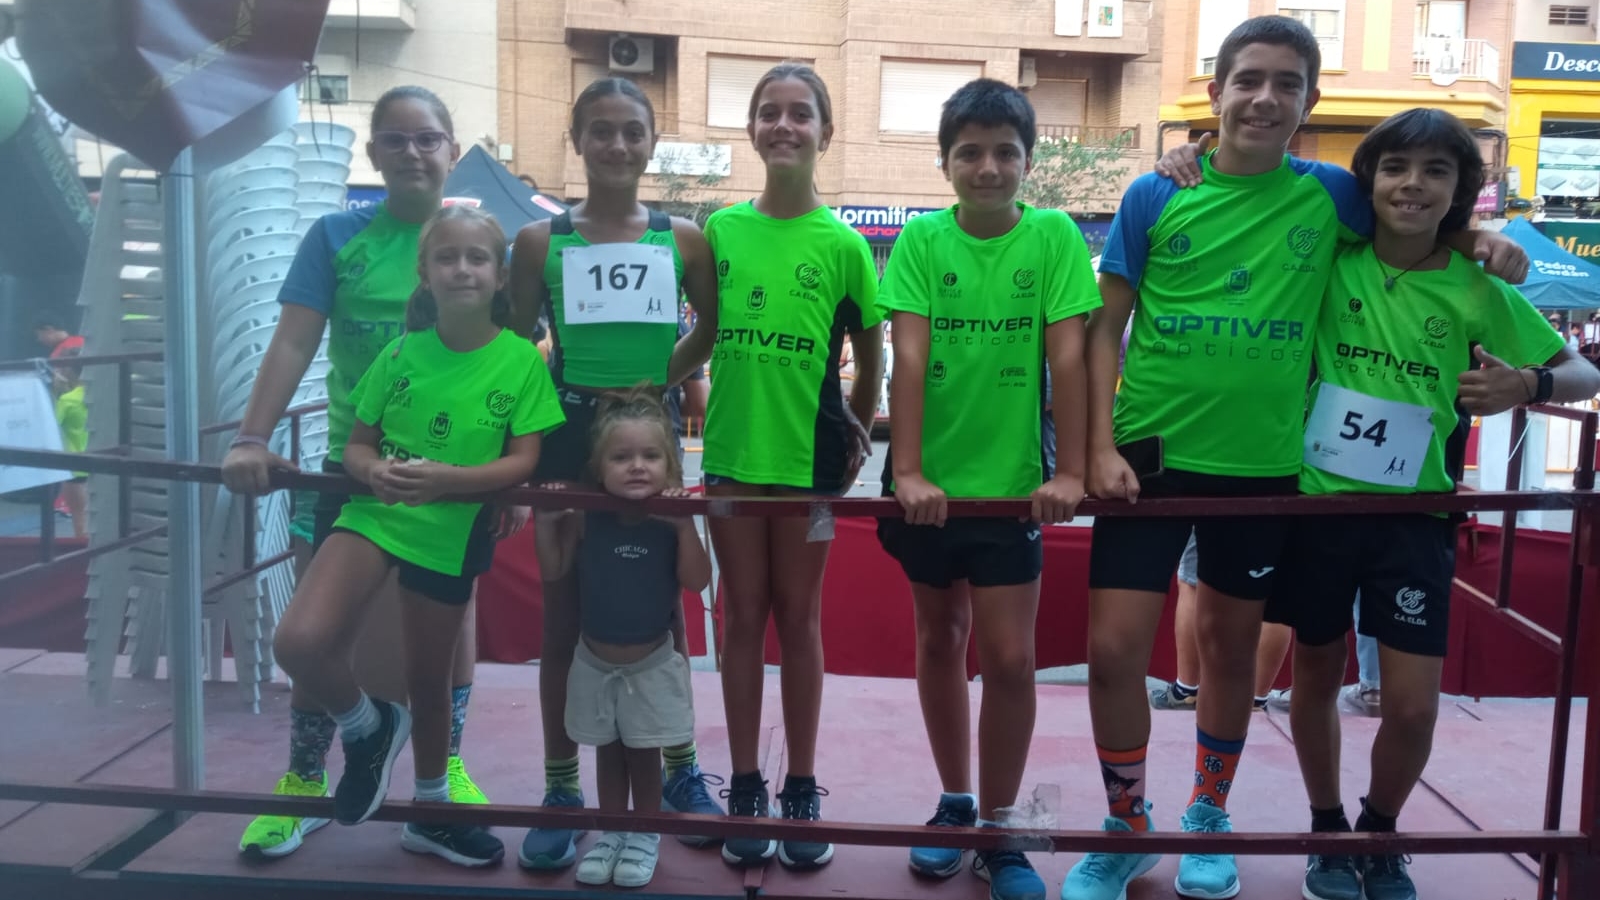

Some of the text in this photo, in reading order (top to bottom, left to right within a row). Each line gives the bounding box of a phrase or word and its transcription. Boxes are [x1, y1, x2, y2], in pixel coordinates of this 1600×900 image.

[1544, 51, 1600, 72] Desc
[587, 263, 649, 292] 167
[934, 316, 1034, 333] OPTIVER
[1154, 314, 1304, 341] OPTIVER
[1336, 342, 1441, 381] OPTIVER
[1339, 410, 1389, 448] 54
[614, 545, 649, 555] CHICAGO
